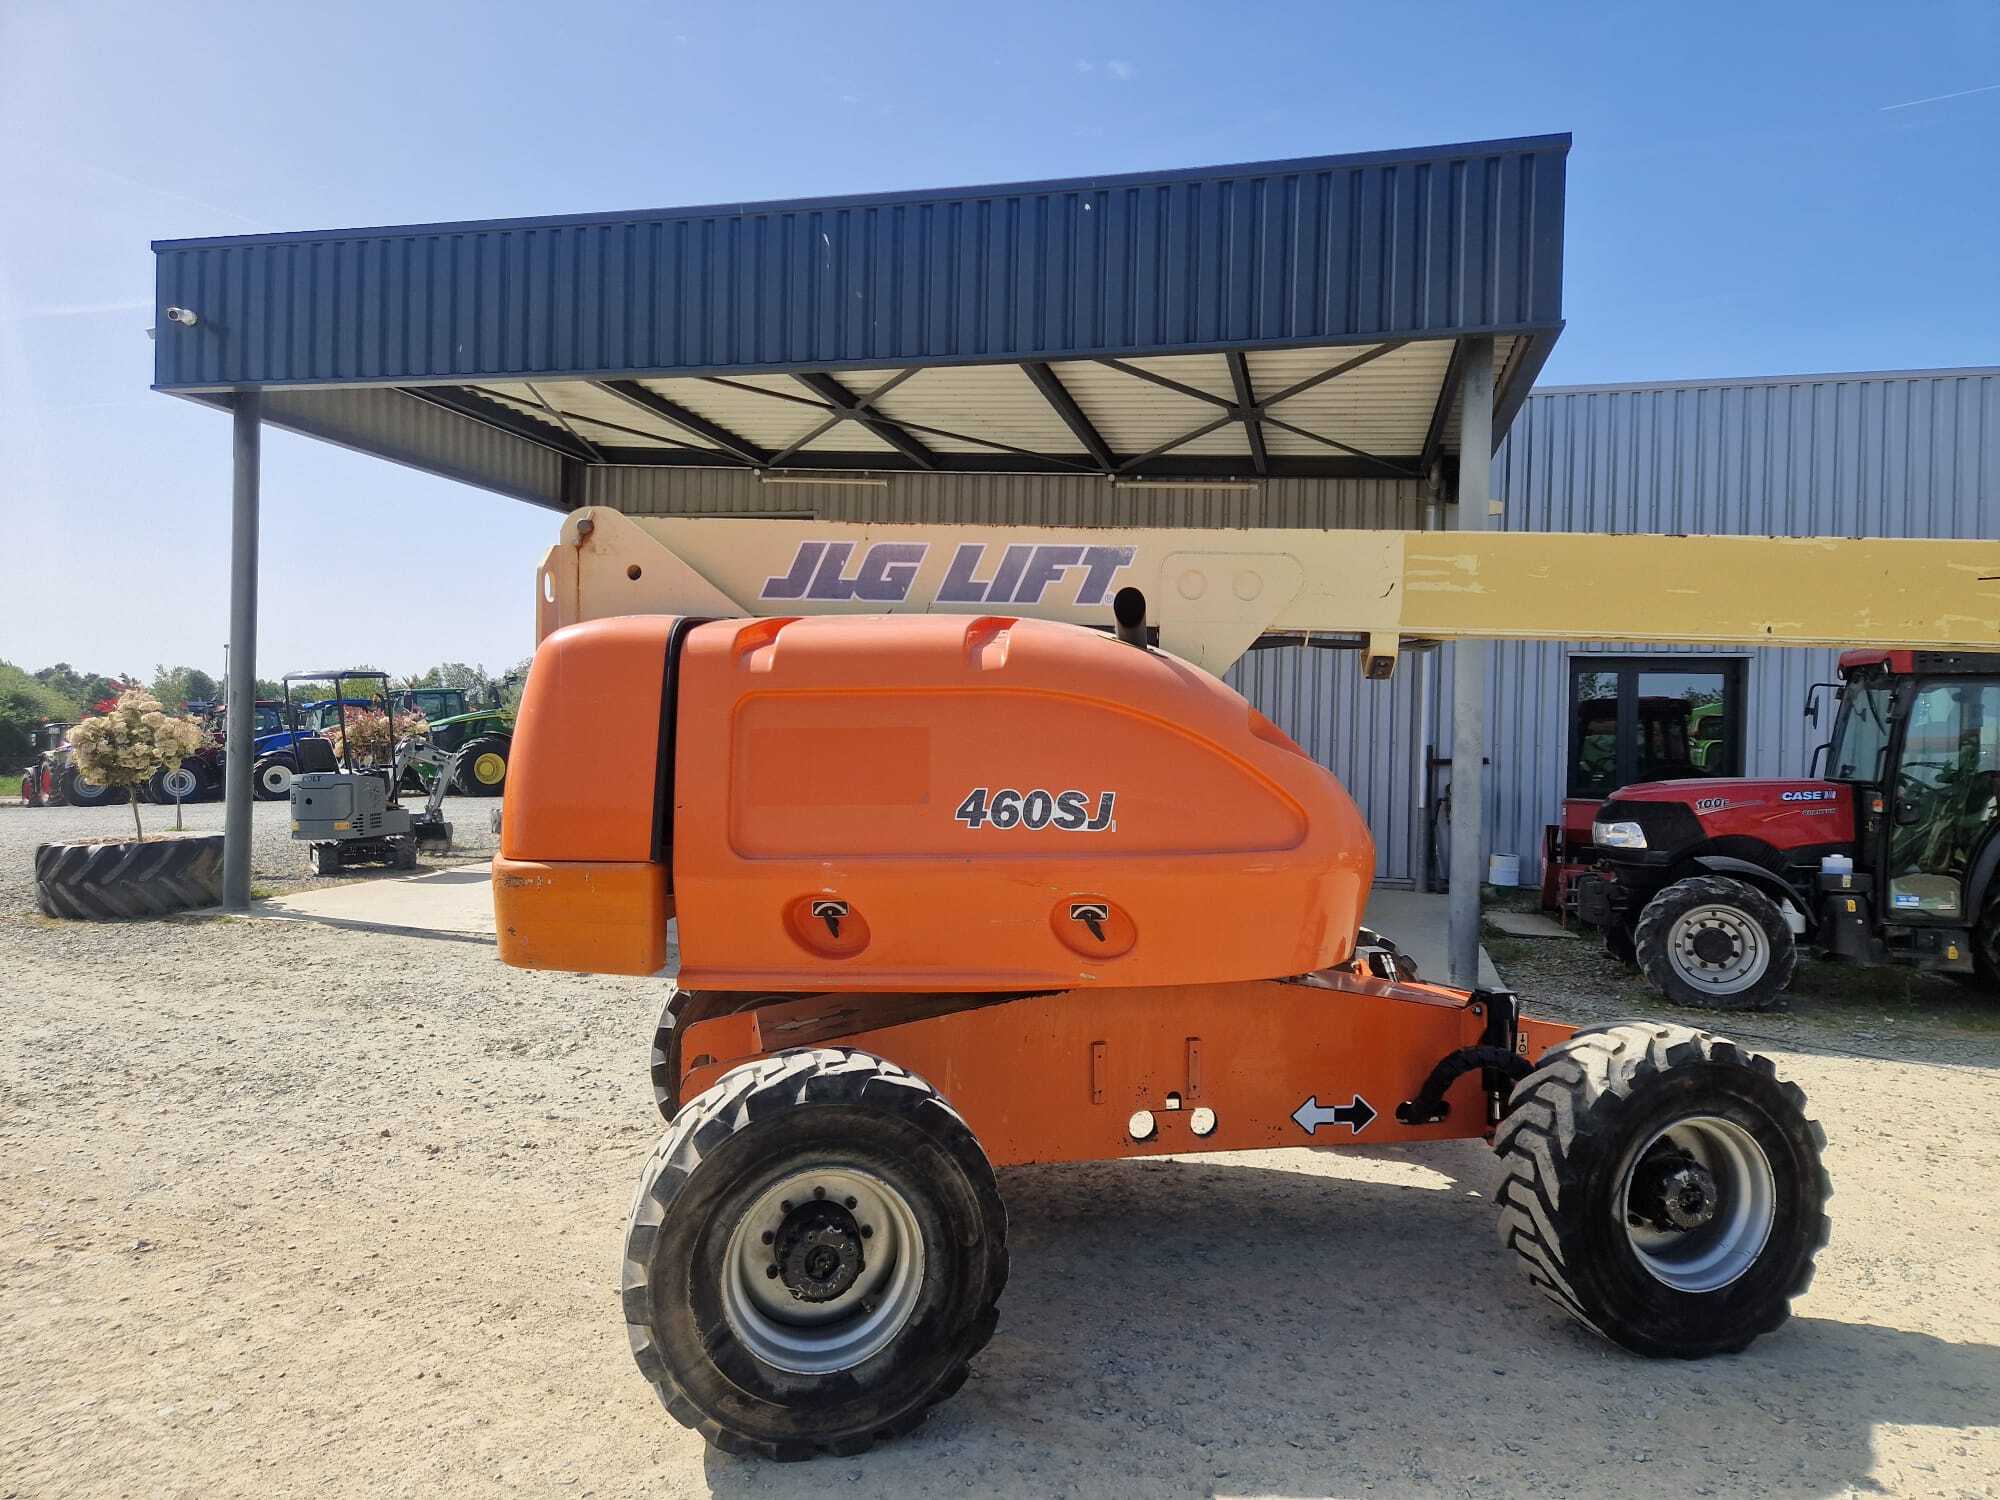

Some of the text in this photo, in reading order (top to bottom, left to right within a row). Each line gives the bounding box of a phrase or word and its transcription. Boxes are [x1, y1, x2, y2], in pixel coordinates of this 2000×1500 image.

[760, 540, 1138, 605] JLG LIFT
[955, 788, 1116, 832] 460SJ
[1782, 791, 1821, 801] CASE
